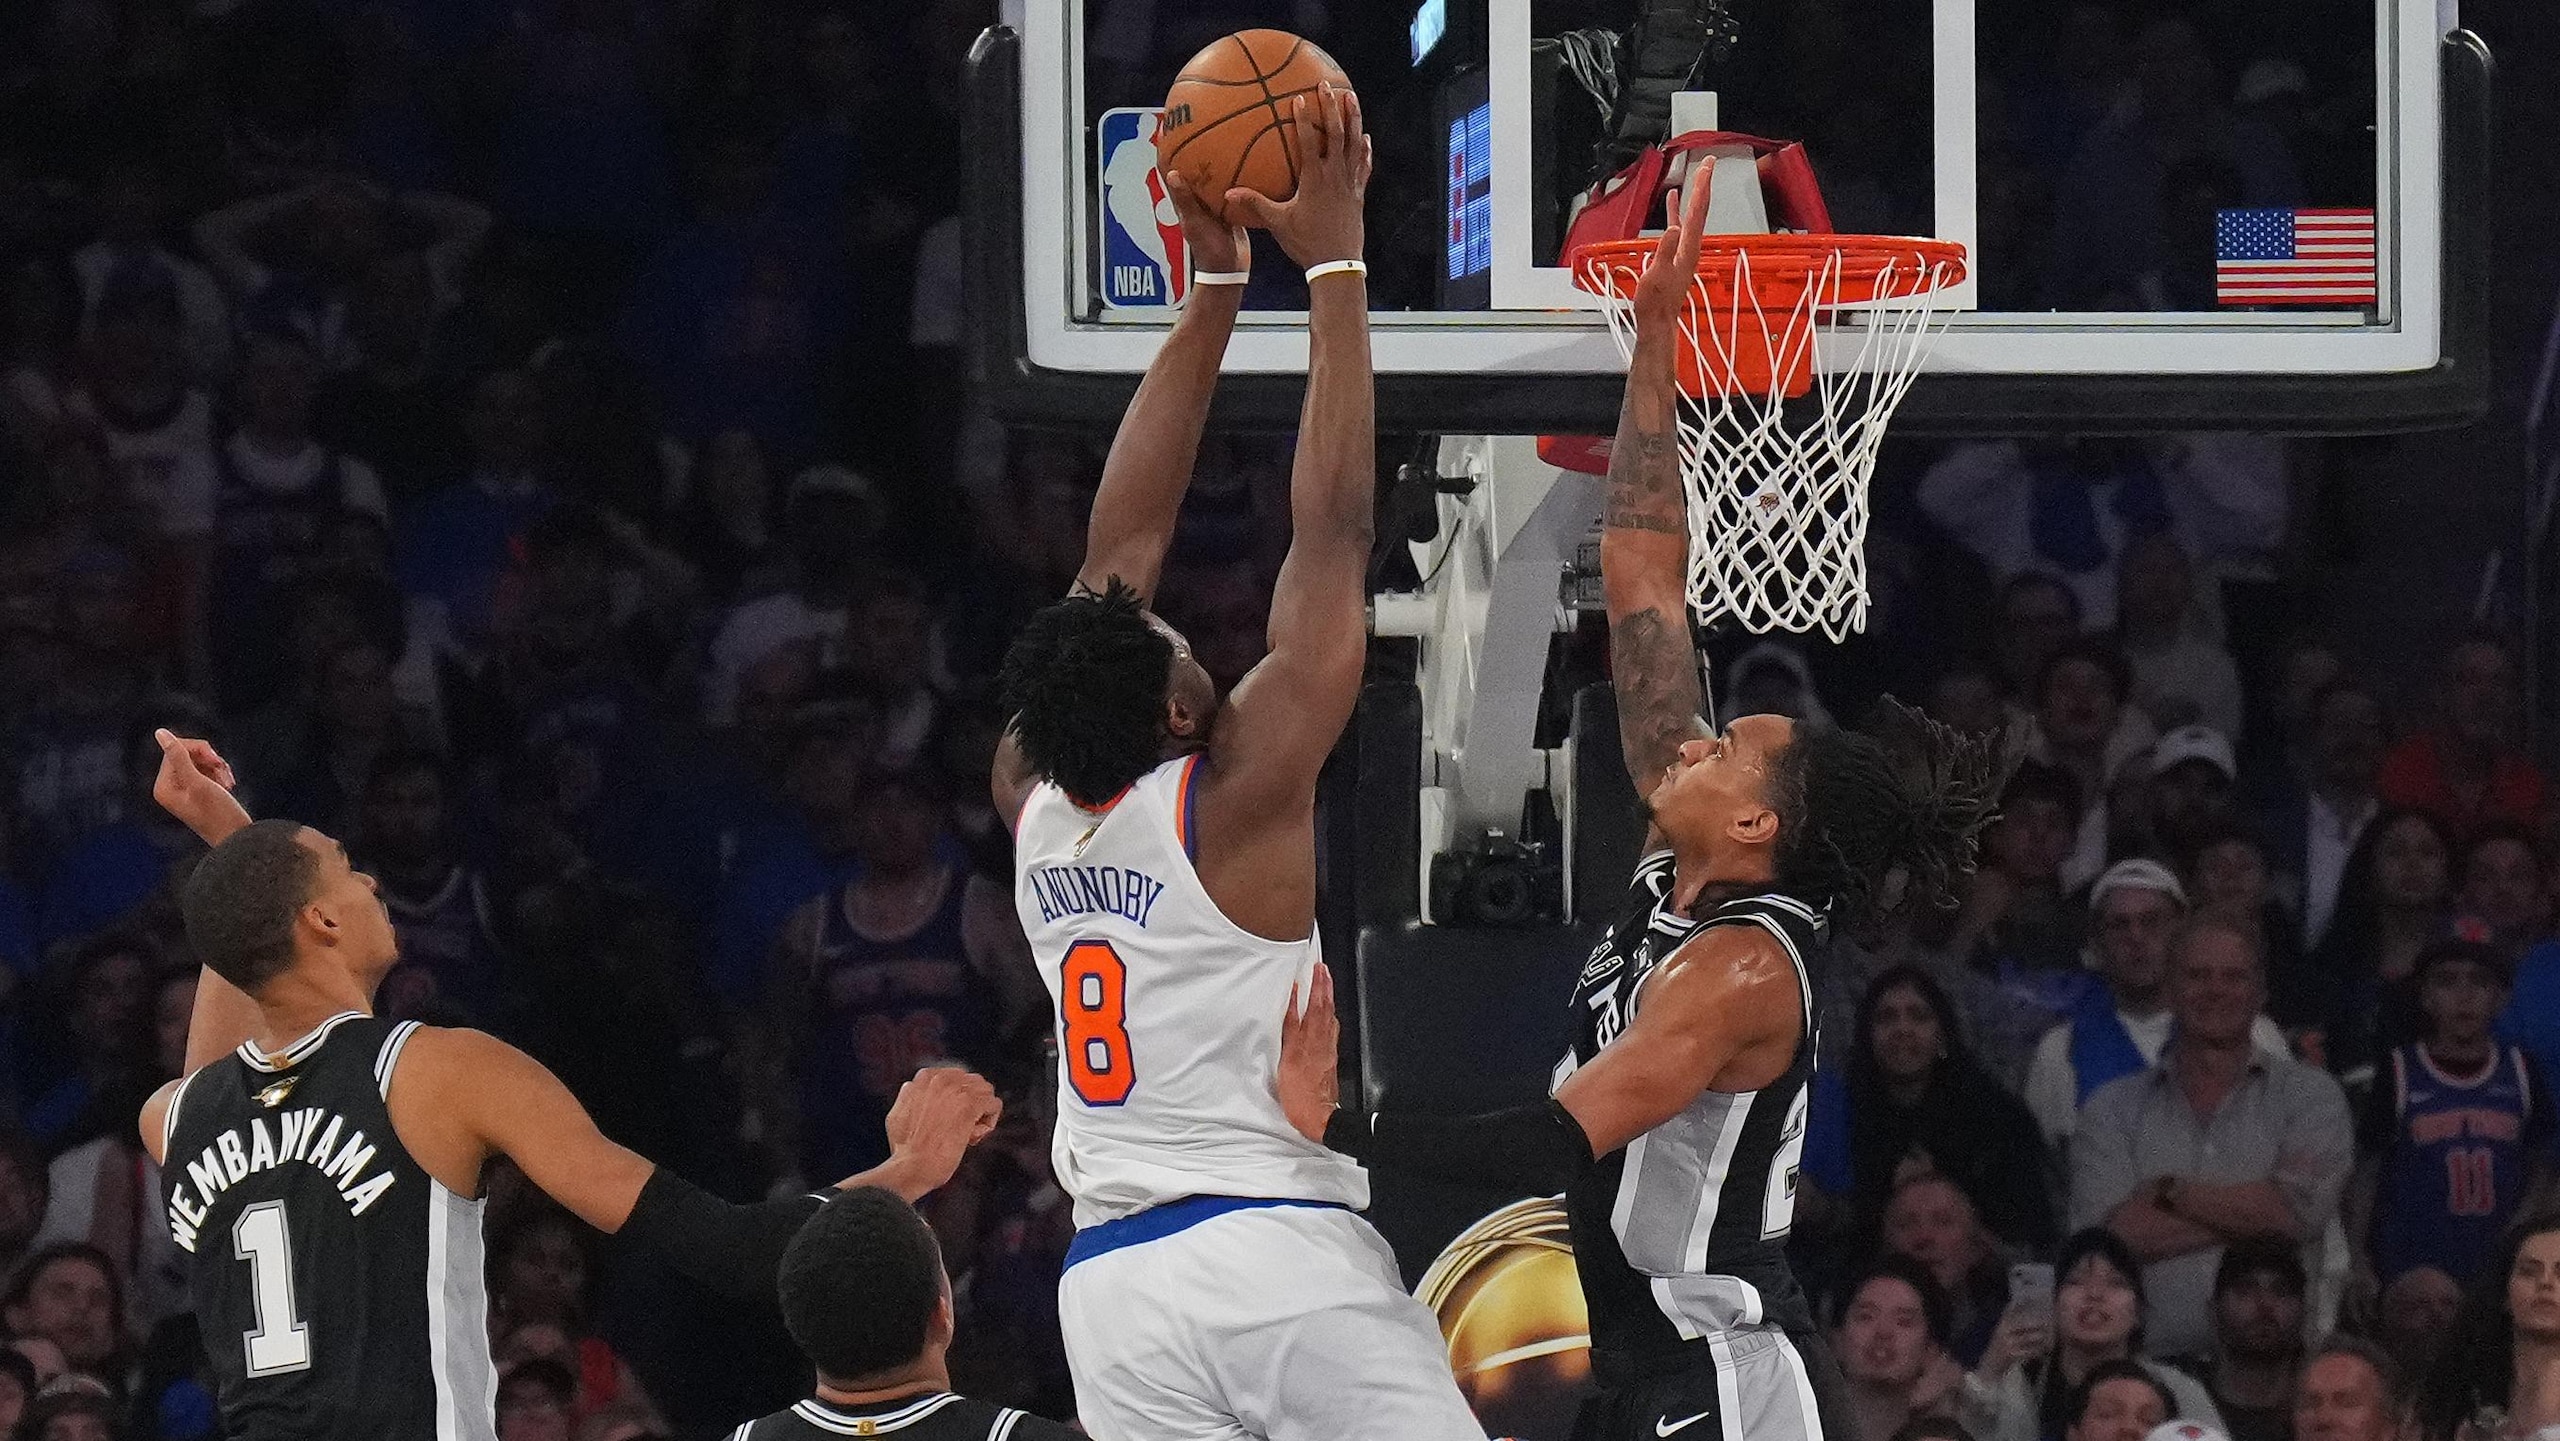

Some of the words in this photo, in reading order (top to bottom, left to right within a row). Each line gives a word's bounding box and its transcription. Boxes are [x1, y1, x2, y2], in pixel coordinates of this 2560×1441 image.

[1114, 266, 1156, 297] NBA
[1030, 866, 1165, 929] ANUNOBY
[1060, 939, 1137, 1108] 8
[169, 1107, 396, 1254] WEMBANYAMA
[232, 1199, 311, 1379] 1
